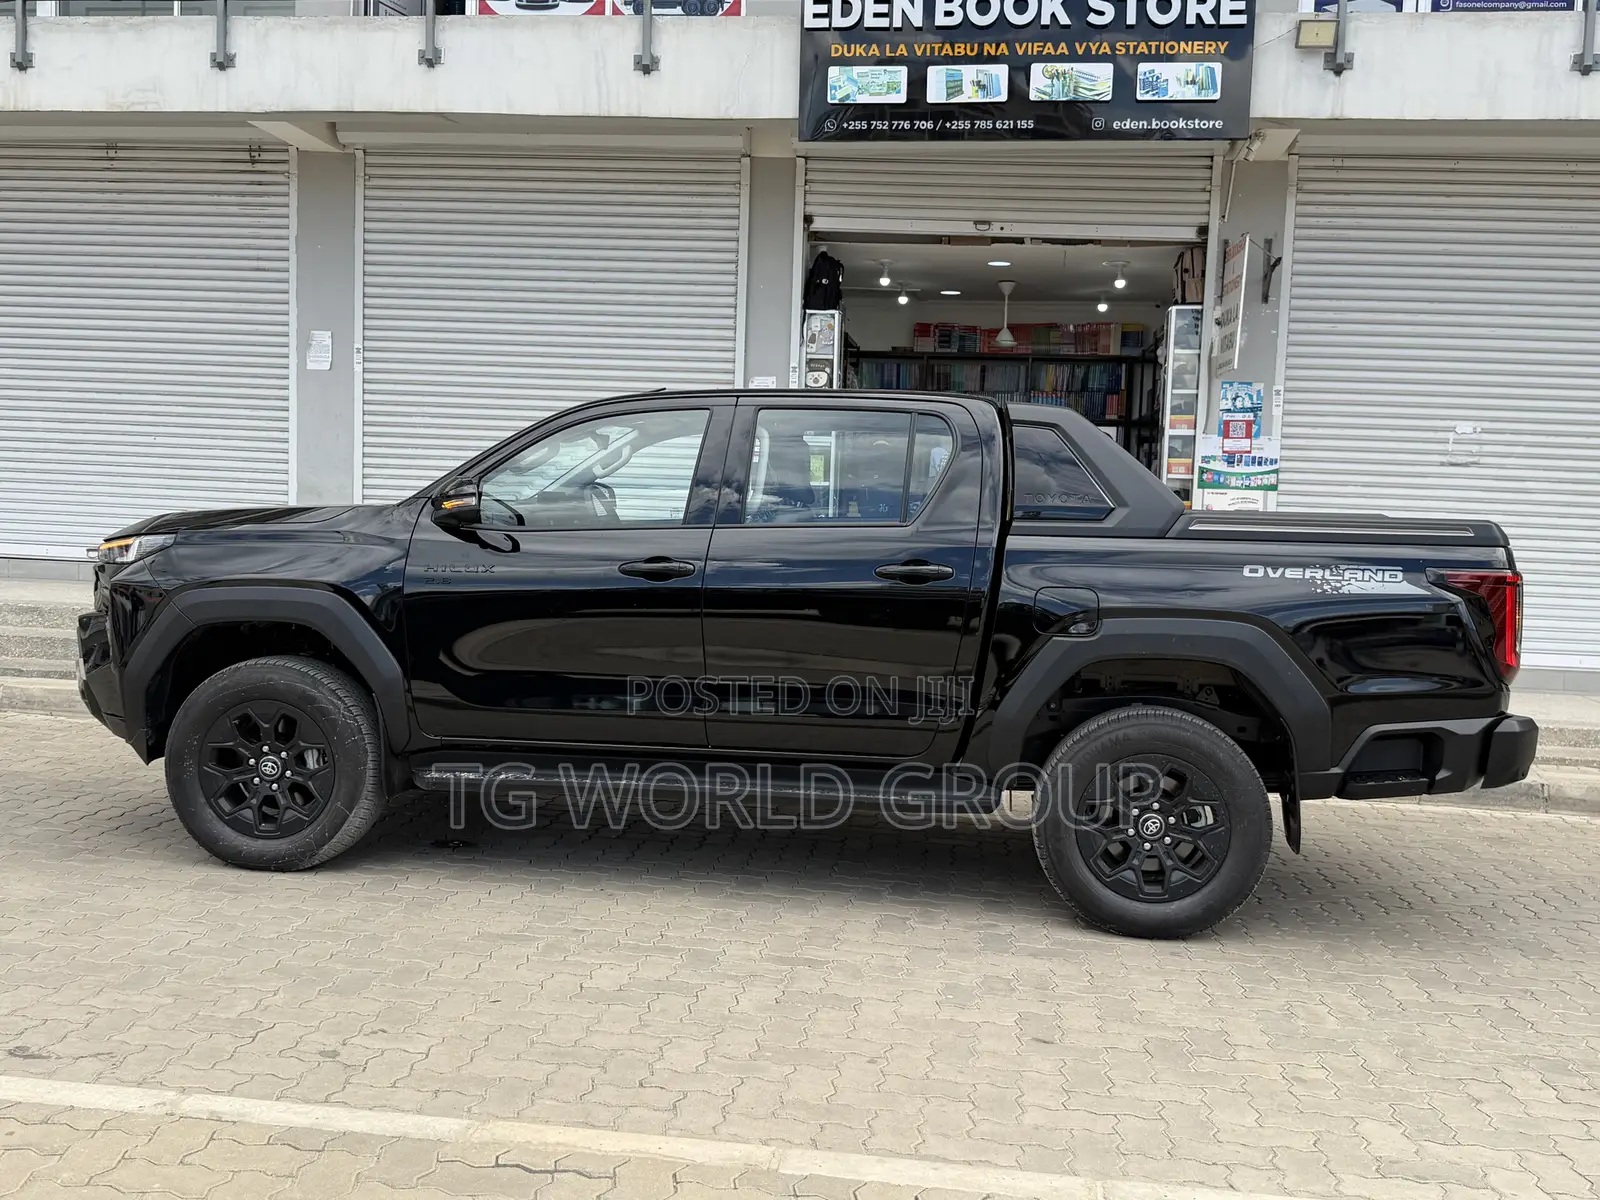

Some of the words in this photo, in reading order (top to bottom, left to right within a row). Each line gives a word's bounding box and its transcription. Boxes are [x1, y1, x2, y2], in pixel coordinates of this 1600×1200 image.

[803, 0, 923, 29] EDEN
[934, 0, 1072, 28] BOOK
[1086, 0, 1248, 26] STORE
[830, 43, 881, 57] DUKA
[885, 43, 908, 57] LA
[913, 43, 979, 57] VITABU
[983, 42, 1009, 56] NA
[1015, 42, 1069, 56] VIFAA
[1075, 41, 1111, 56] VYA
[1115, 41, 1229, 56] STATIONERY
[842, 120, 868, 130] +255
[870, 120, 889, 130] 752
[891, 120, 911, 130] 776
[913, 120, 934, 130] 706
[936, 119, 943, 131] /
[945, 120, 971, 130] +255
[973, 120, 993, 130] 785
[995, 120, 1014, 130] 621
[1016, 119, 1034, 129] 155
[1112, 117, 1224, 130] eden.bookstore
[1024, 492, 1092, 504] TOYOTA
[424, 563, 495, 574] HILUX
[1242, 564, 1404, 583] OVERLAND
